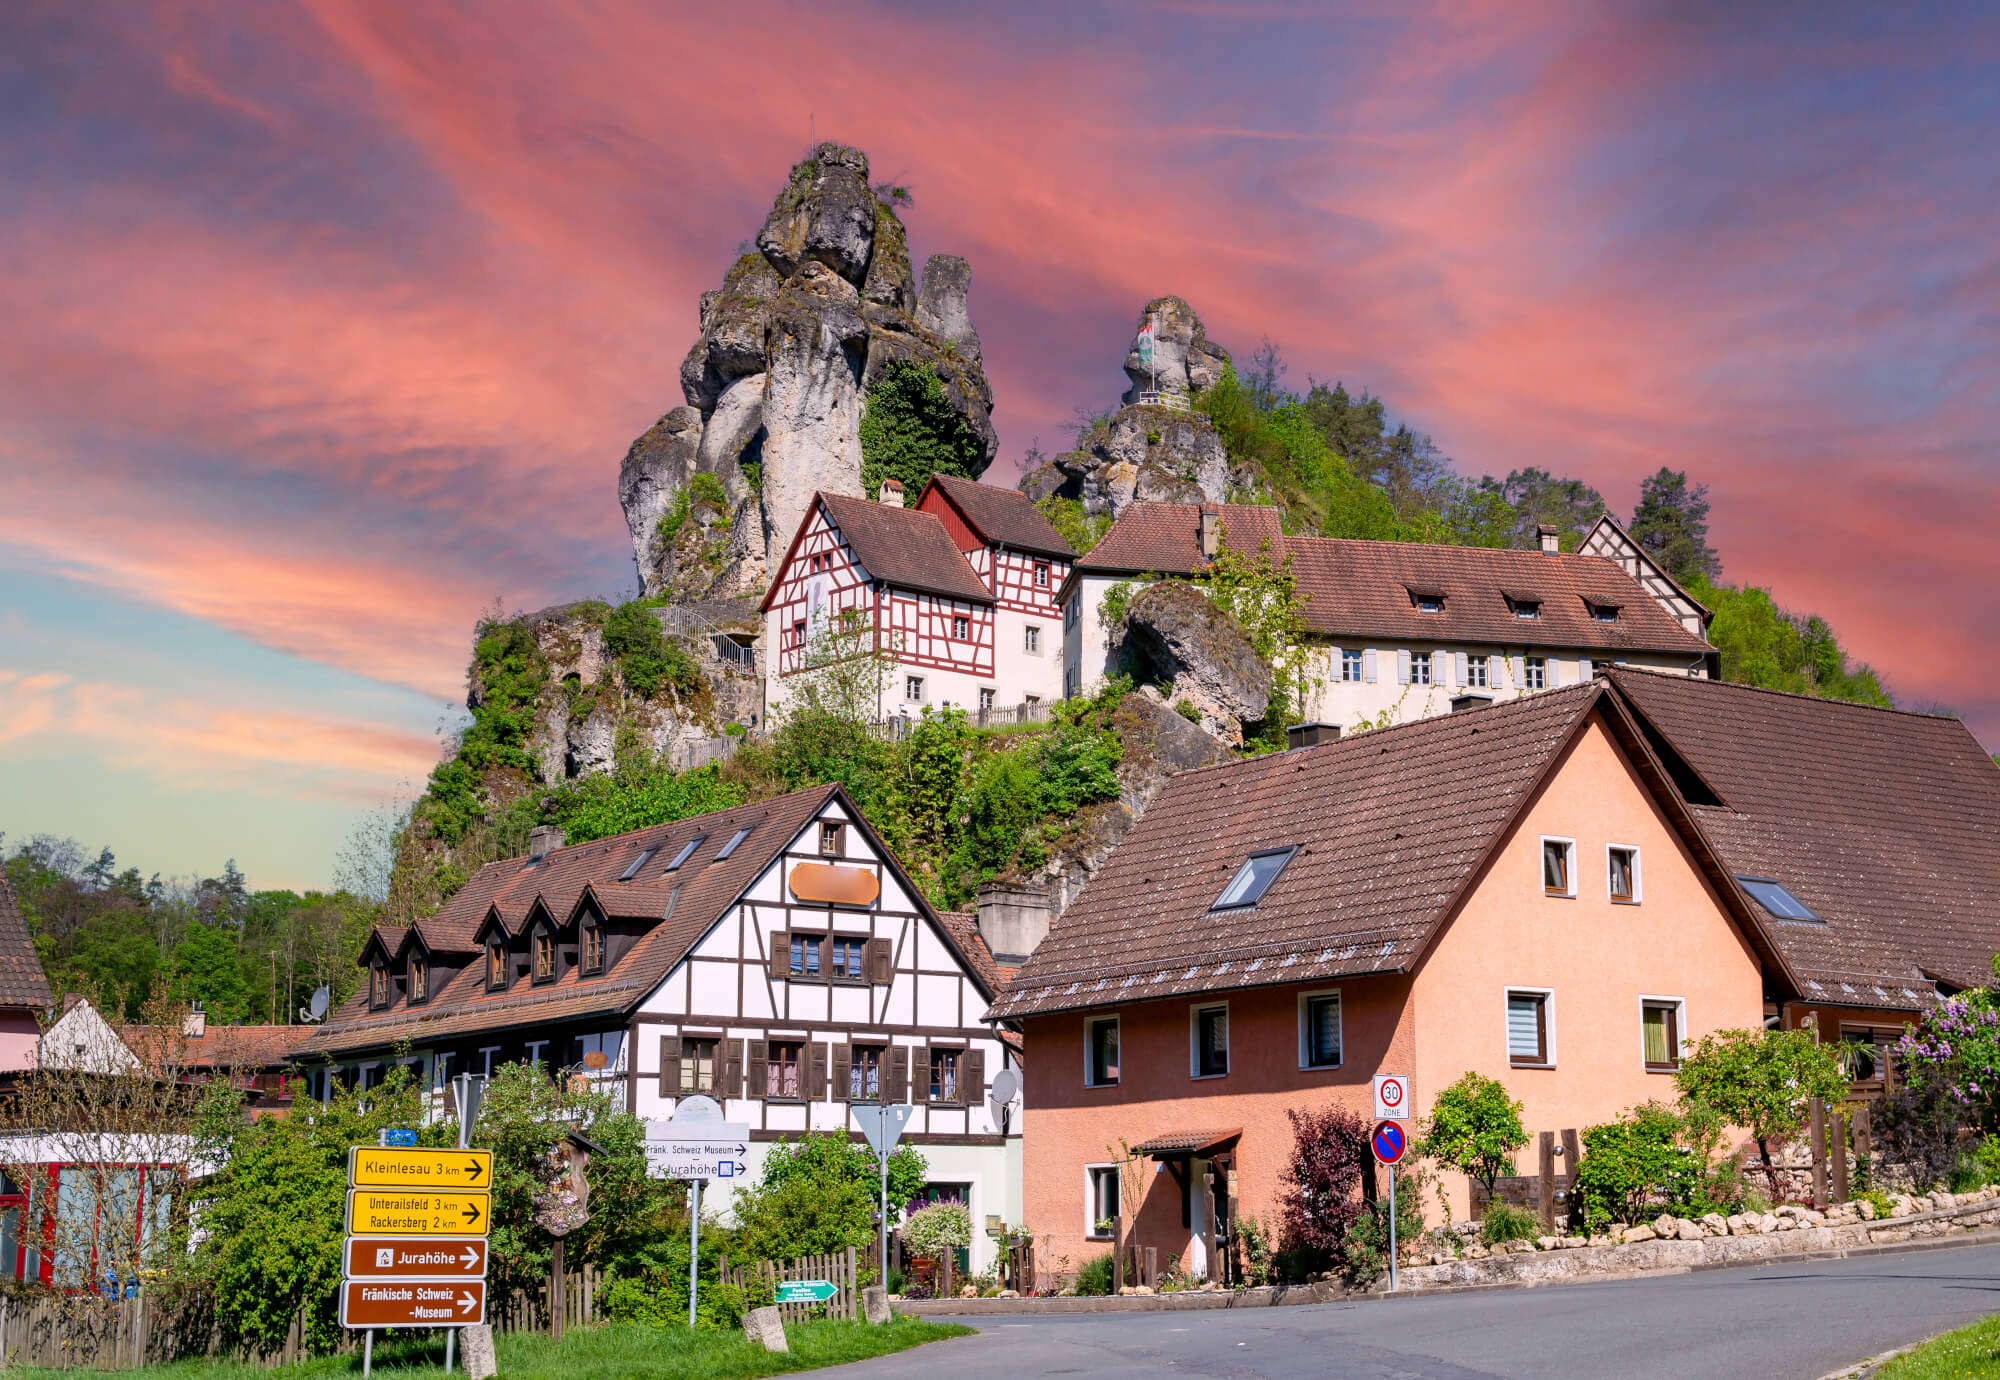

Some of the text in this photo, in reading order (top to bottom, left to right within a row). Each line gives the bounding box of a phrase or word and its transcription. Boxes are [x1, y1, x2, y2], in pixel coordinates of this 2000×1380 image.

[1384, 1086, 1399, 1100] 30
[1383, 1108, 1401, 1117] ZONE
[646, 1144, 734, 1154] Fränk. Schweiz Museum
[365, 1161, 460, 1176] Kleinlesau 3 km
[369, 1197, 458, 1211] Unterailsfeld 3 km
[370, 1216, 457, 1231] Rackersberg 2 km
[397, 1251, 456, 1265] Jurahöhe
[361, 1287, 454, 1301] Fränkische Schweiz
[409, 1306, 453, 1318] -Museum
